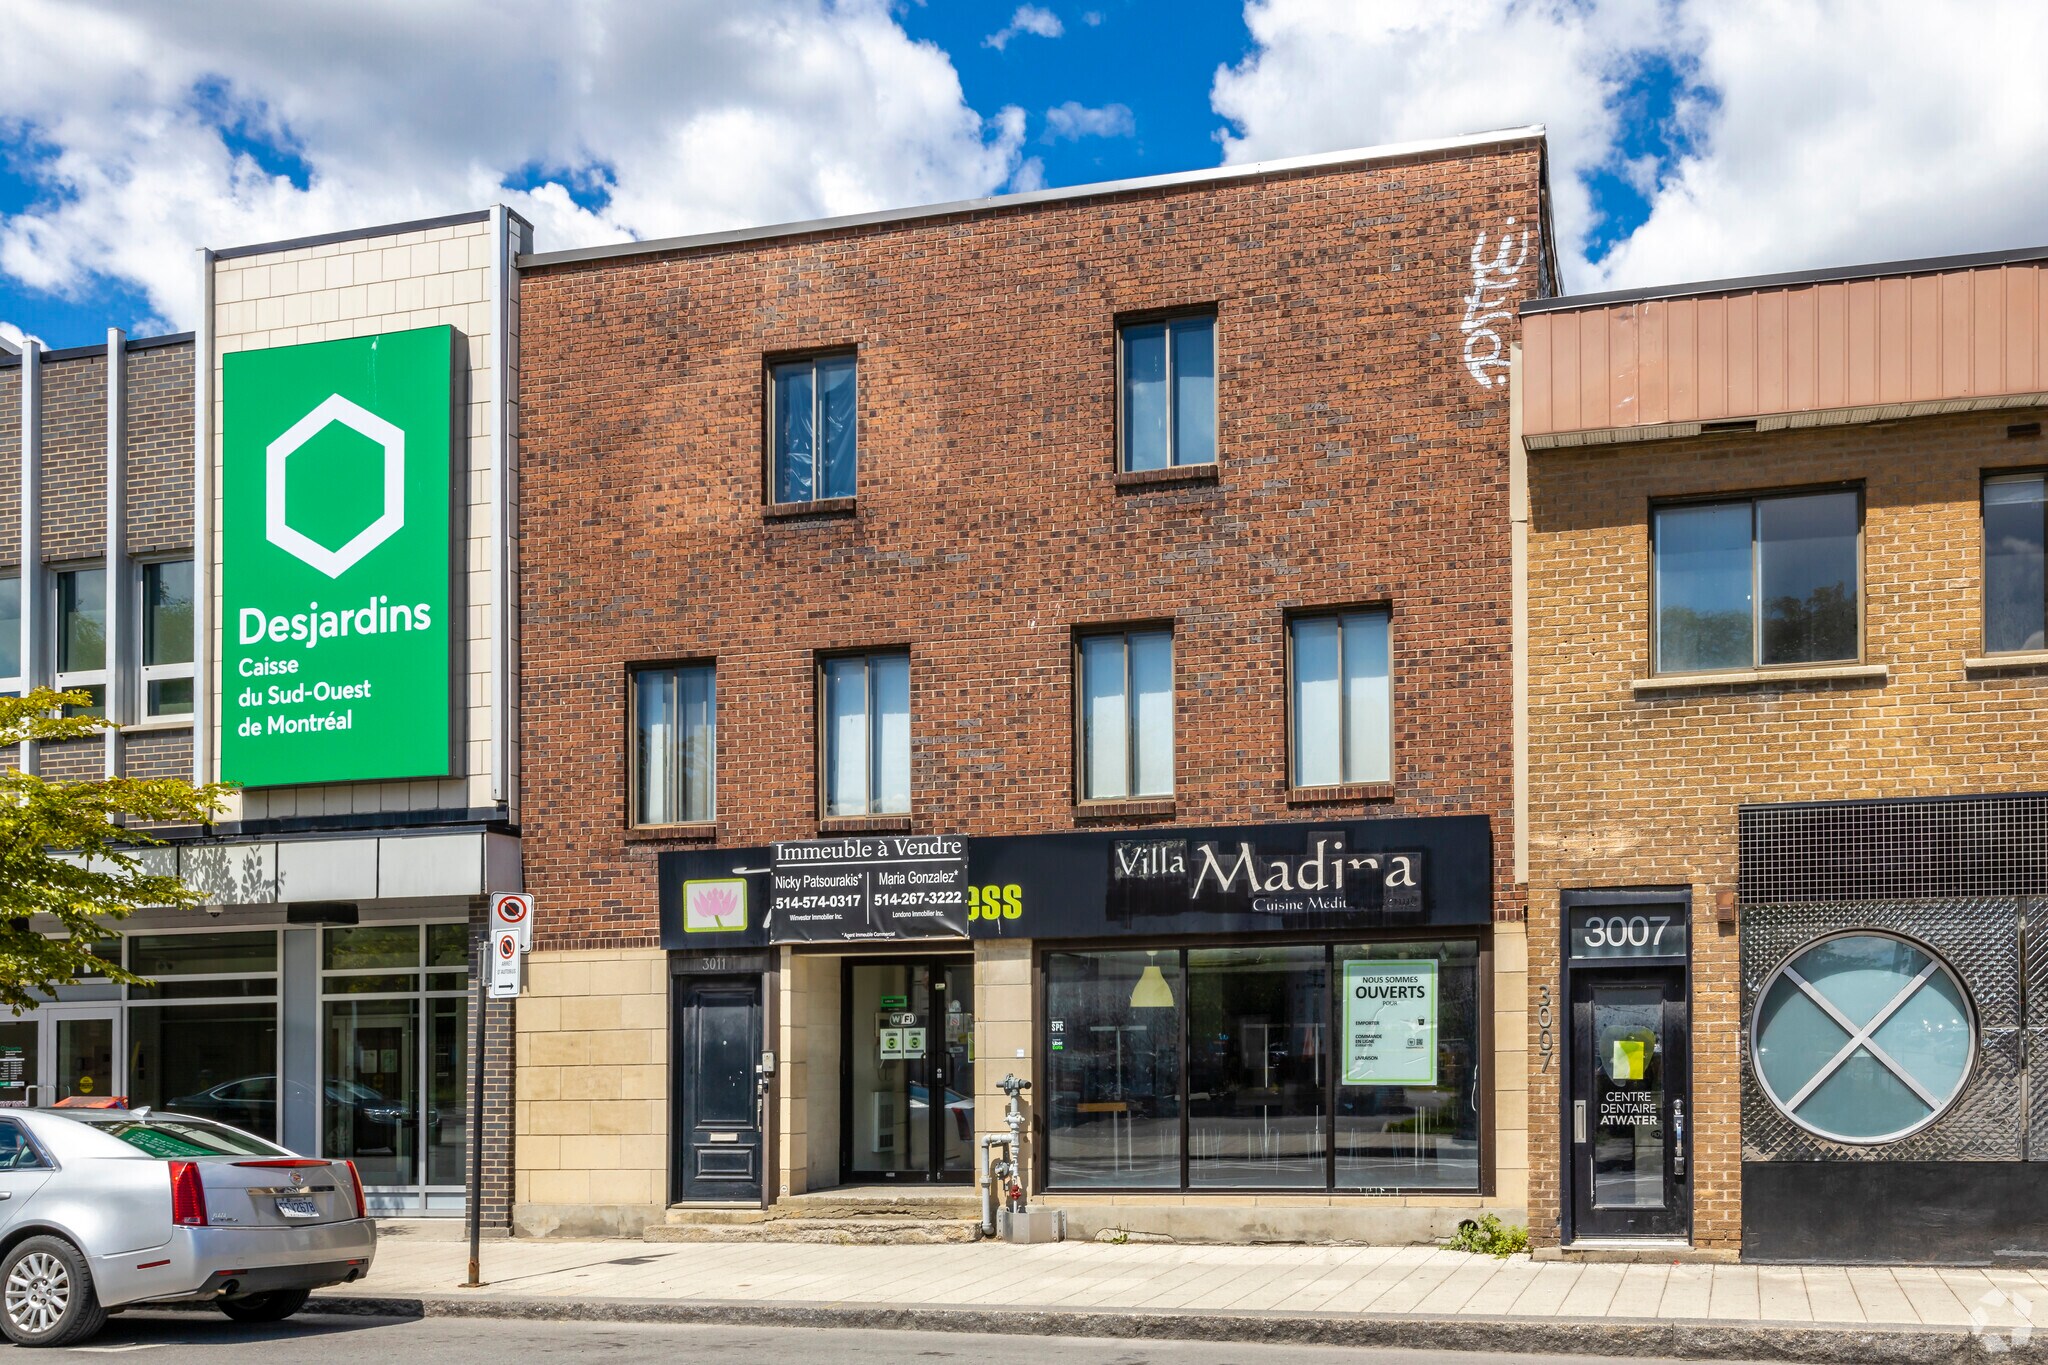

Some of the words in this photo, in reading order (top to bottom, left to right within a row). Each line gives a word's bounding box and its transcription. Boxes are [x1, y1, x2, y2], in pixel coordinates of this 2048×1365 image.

[239, 595, 431, 648] Desjardins
[239, 656, 299, 677] Caisse
[238, 687, 262, 707] du
[268, 680, 371, 705] Sud-Ouest
[238, 717, 262, 737] de
[267, 710, 352, 735] Montréal
[776, 840, 872, 860] Immeuble
[878, 840, 888, 857] à
[894, 836, 962, 856] Vendre
[1116, 847, 1185, 876] Villa
[775, 876, 801, 891] Nicky
[879, 873, 905, 886] Maria
[776, 895, 861, 909] 514-574-0317
[874, 892, 961, 906] 514-267-3222
[1253, 898, 1303, 911] Cuisine
[892, 910, 911, 918] Londono
[1584, 915, 1671, 947] 3007
[702, 957, 726, 970] 3011
[1355, 986, 1425, 999] OUVERTS
[1051, 1023, 1064, 1031] SPC
[1538, 984, 1553, 1074] 3007
[1605, 1091, 1651, 1102] CENTRE
[1600, 1103, 1657, 1113] DENTAIRE
[1600, 1115, 1658, 1125] ATWATER
